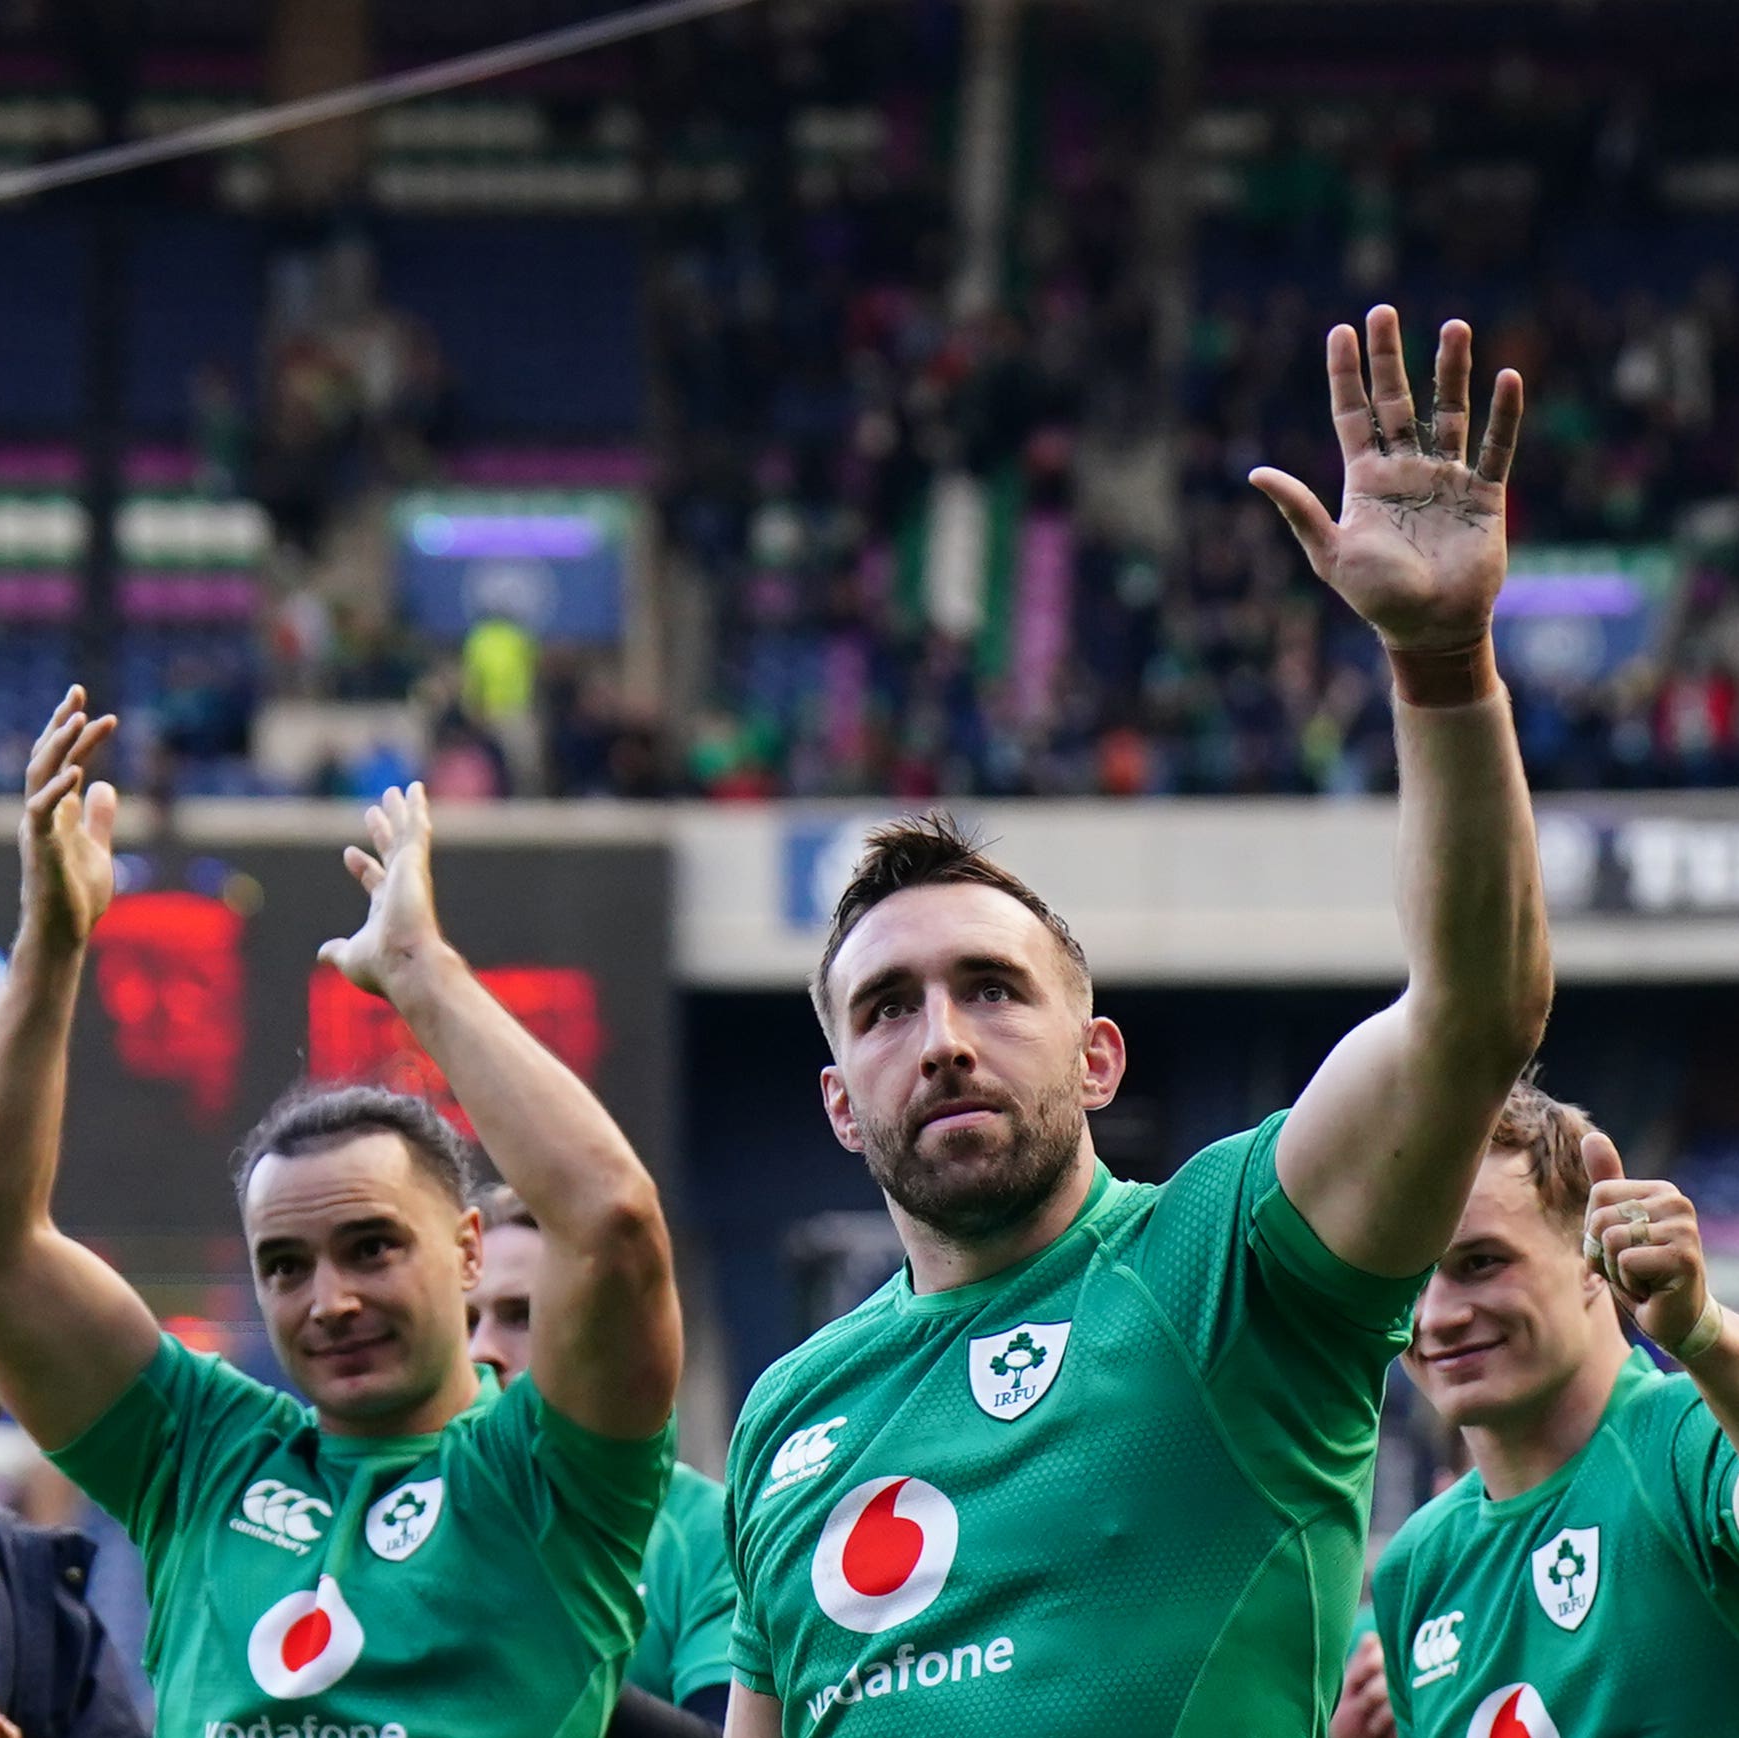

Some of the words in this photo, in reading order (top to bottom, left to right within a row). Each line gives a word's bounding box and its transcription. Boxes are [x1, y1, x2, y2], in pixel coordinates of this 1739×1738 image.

[993, 1385, 1038, 1407] IRFU
[229, 1518, 311, 1556] canterbury
[1557, 1594, 1587, 1618] IRFU
